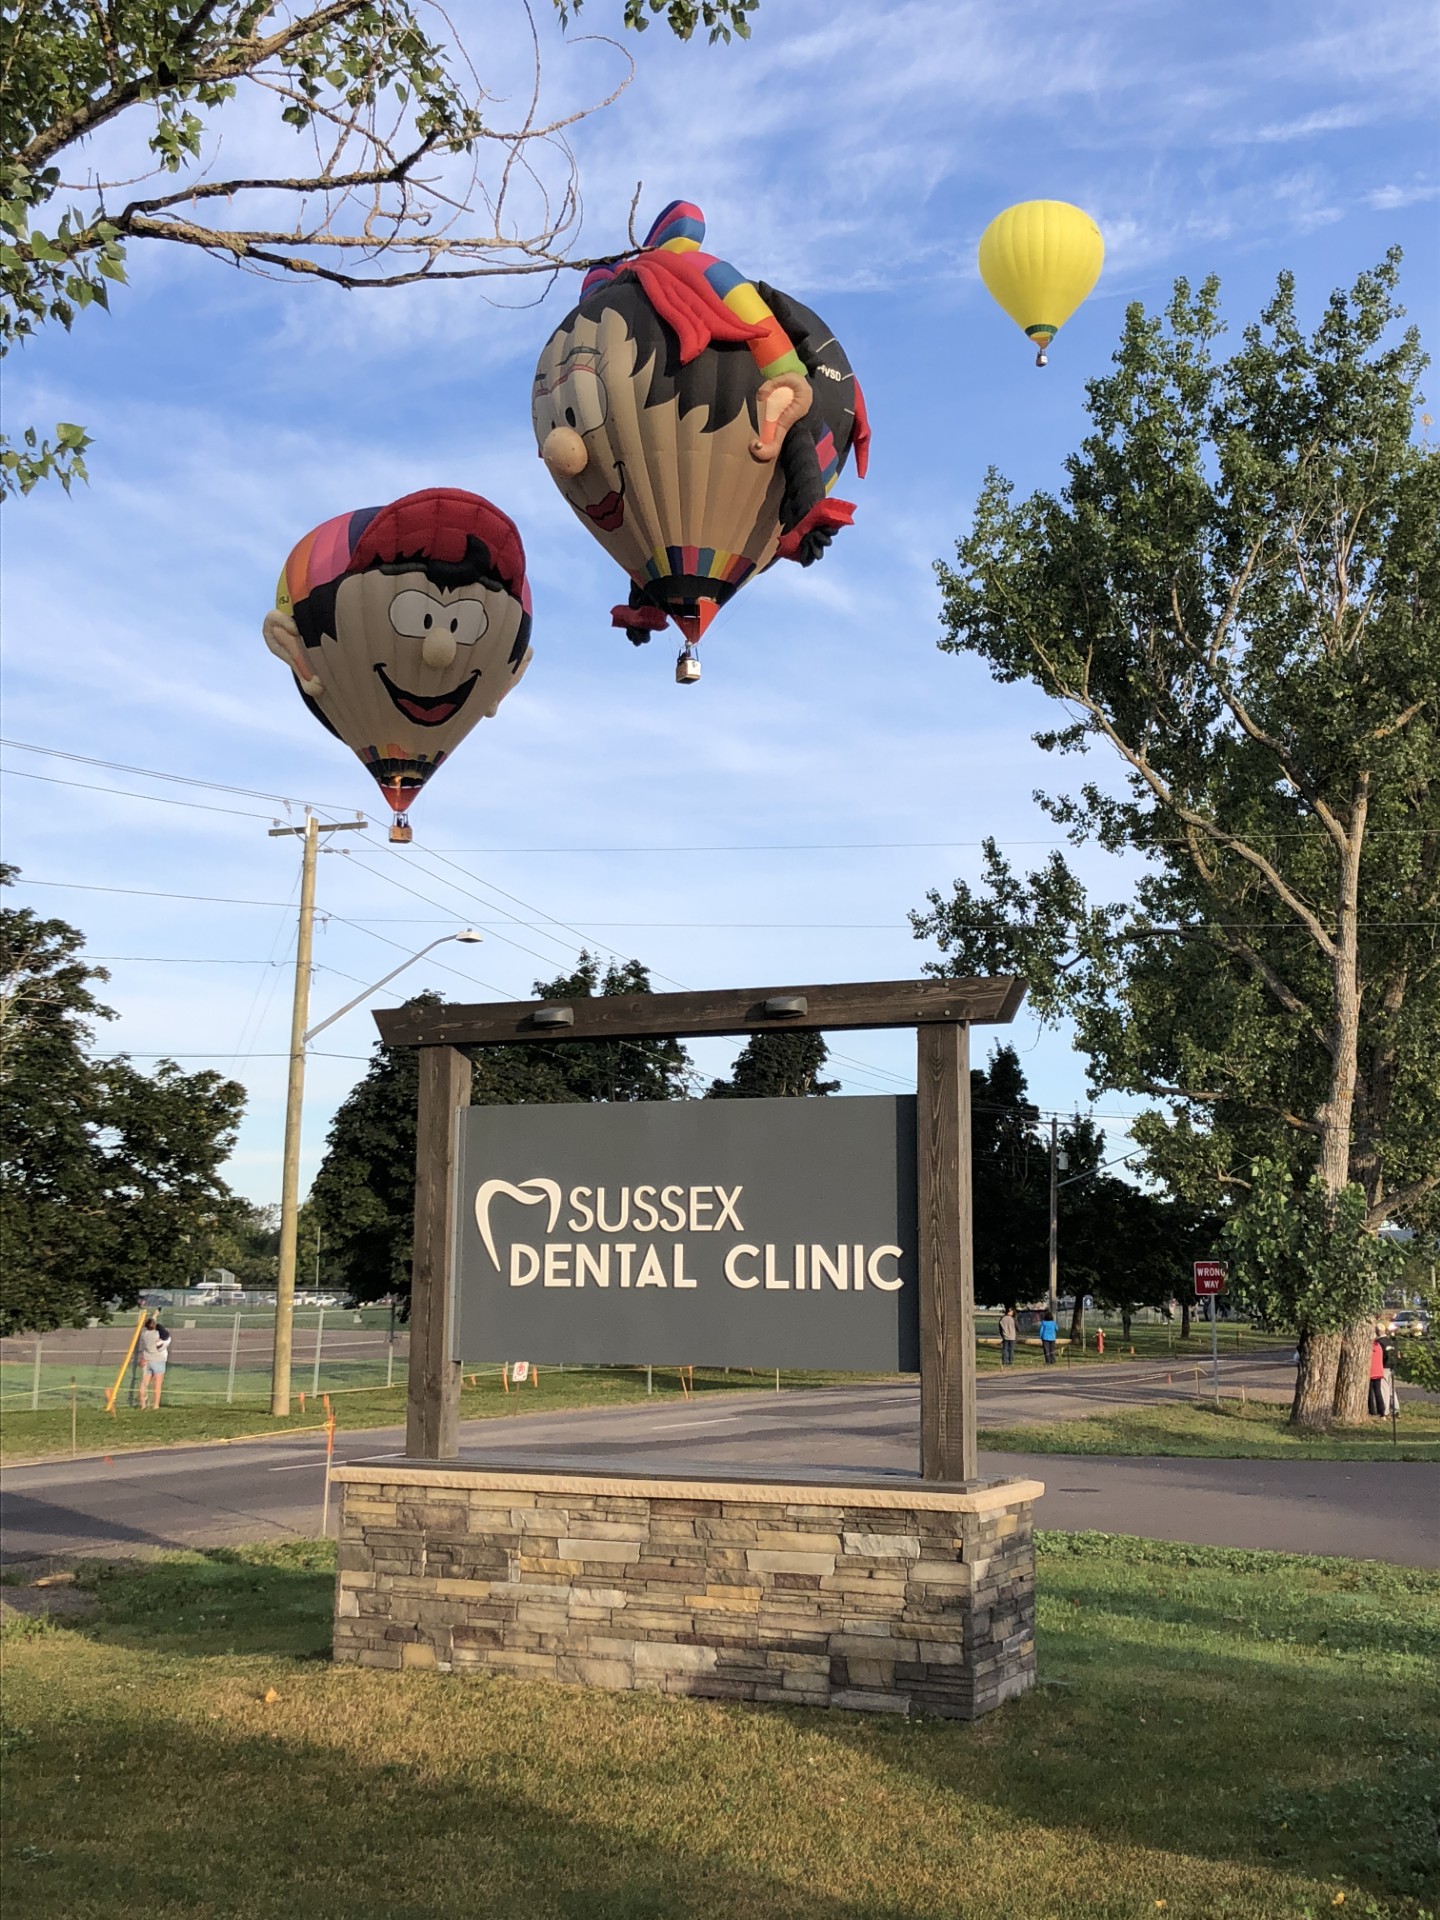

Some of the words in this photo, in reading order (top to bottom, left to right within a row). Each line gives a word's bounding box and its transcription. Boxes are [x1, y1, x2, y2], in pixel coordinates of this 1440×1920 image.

[568, 1185, 745, 1232] SUSSEX
[509, 1243, 697, 1288] DENTAL
[723, 1243, 904, 1291] CLINIC
[1196, 1268, 1226, 1277] WRONG
[1203, 1280, 1220, 1289] WAY
